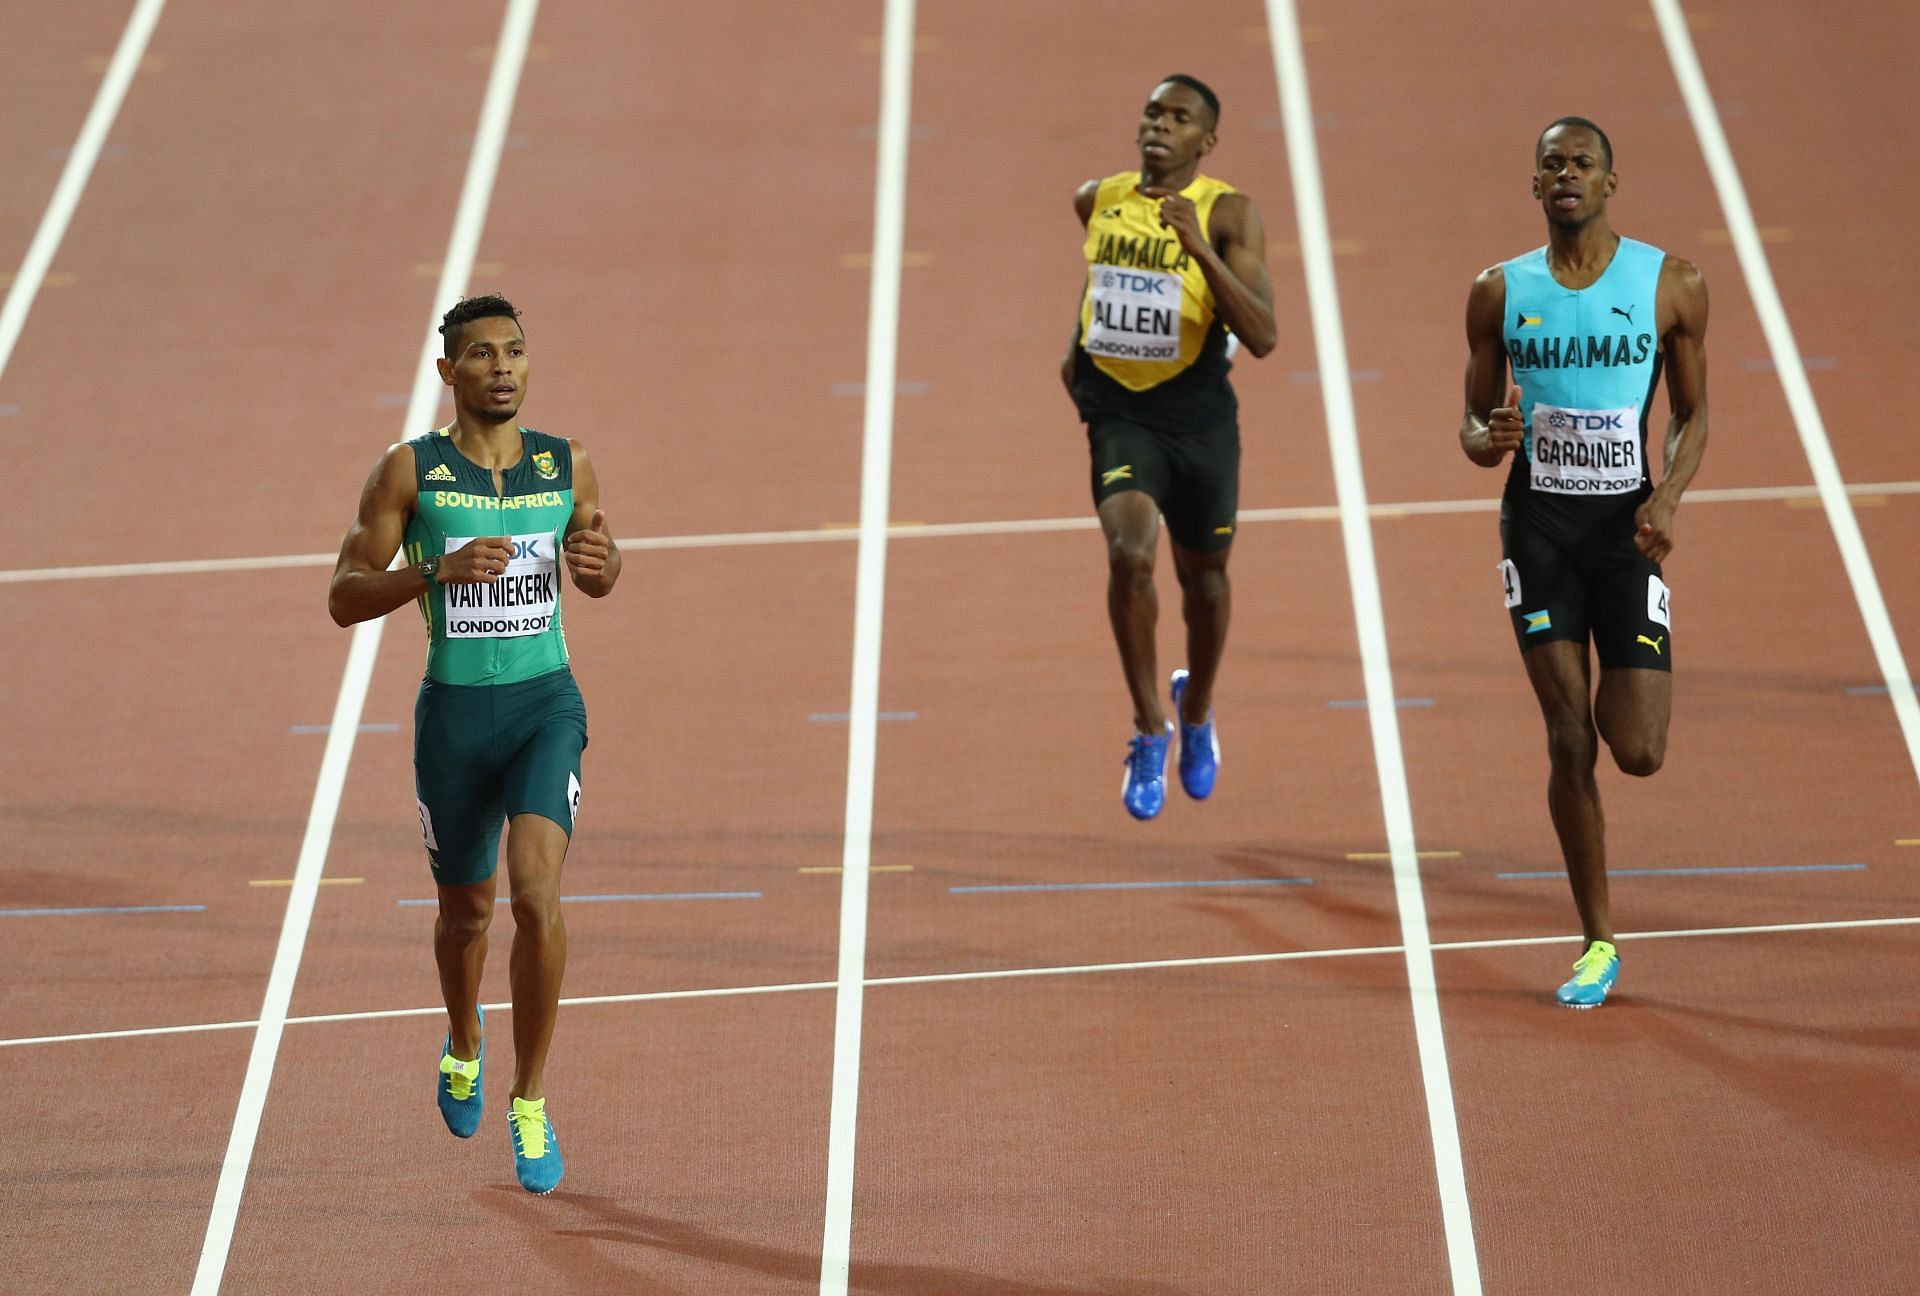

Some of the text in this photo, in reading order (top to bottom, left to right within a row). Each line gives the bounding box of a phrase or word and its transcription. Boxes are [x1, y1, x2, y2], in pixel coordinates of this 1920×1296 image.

[1095, 234, 1189, 271] JAMAICA
[1116, 273, 1164, 295] TDK
[1095, 300, 1171, 336] ALLEN
[1142, 346, 1175, 358] 2017
[1509, 333, 1652, 369] BAHAMAS
[1565, 412, 1623, 430] TDK
[1536, 436, 1635, 468] GARDINER
[425, 473, 457, 482] adidas
[1536, 475, 1637, 492] LONDON 2017
[435, 491, 564, 510] SOUTH AFRICA
[509, 539, 540, 560] DK
[449, 572, 554, 608] VAN NIEKERK
[1658, 589, 1667, 620] 4
[450, 619, 519, 634] LONDON
